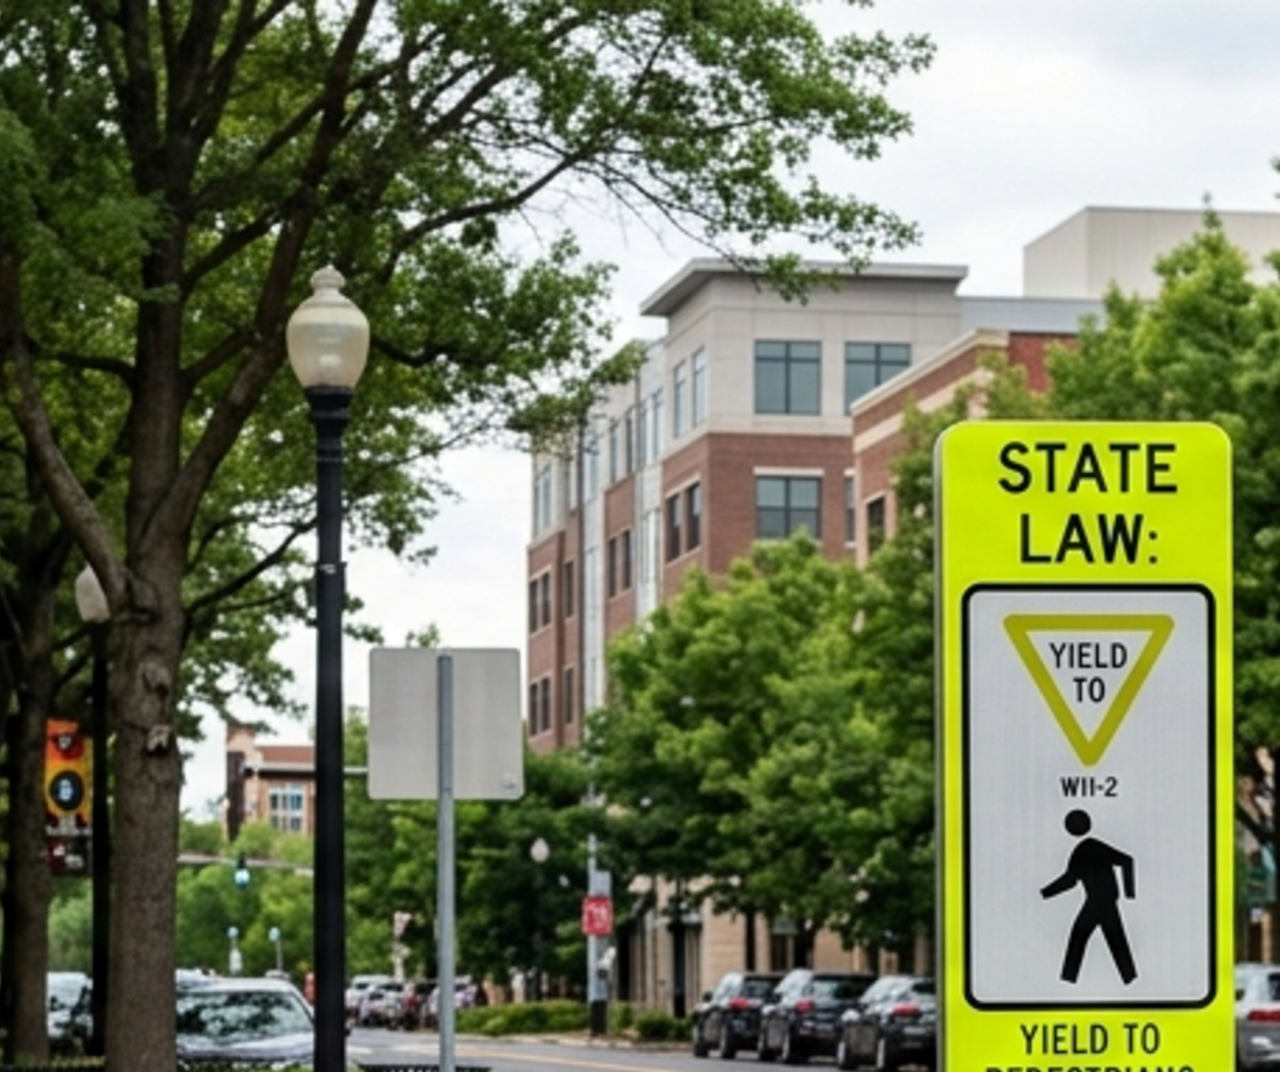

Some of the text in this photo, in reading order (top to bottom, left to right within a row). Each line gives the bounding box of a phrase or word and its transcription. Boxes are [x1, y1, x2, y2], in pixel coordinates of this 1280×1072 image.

[998, 442, 1178, 495] STATE
[1020, 513, 1158, 564] LAW:
[1049, 643, 1128, 669] YIELD
[1073, 677, 1105, 703] TO
[1020, 1023, 1161, 1055] YIELD TO
